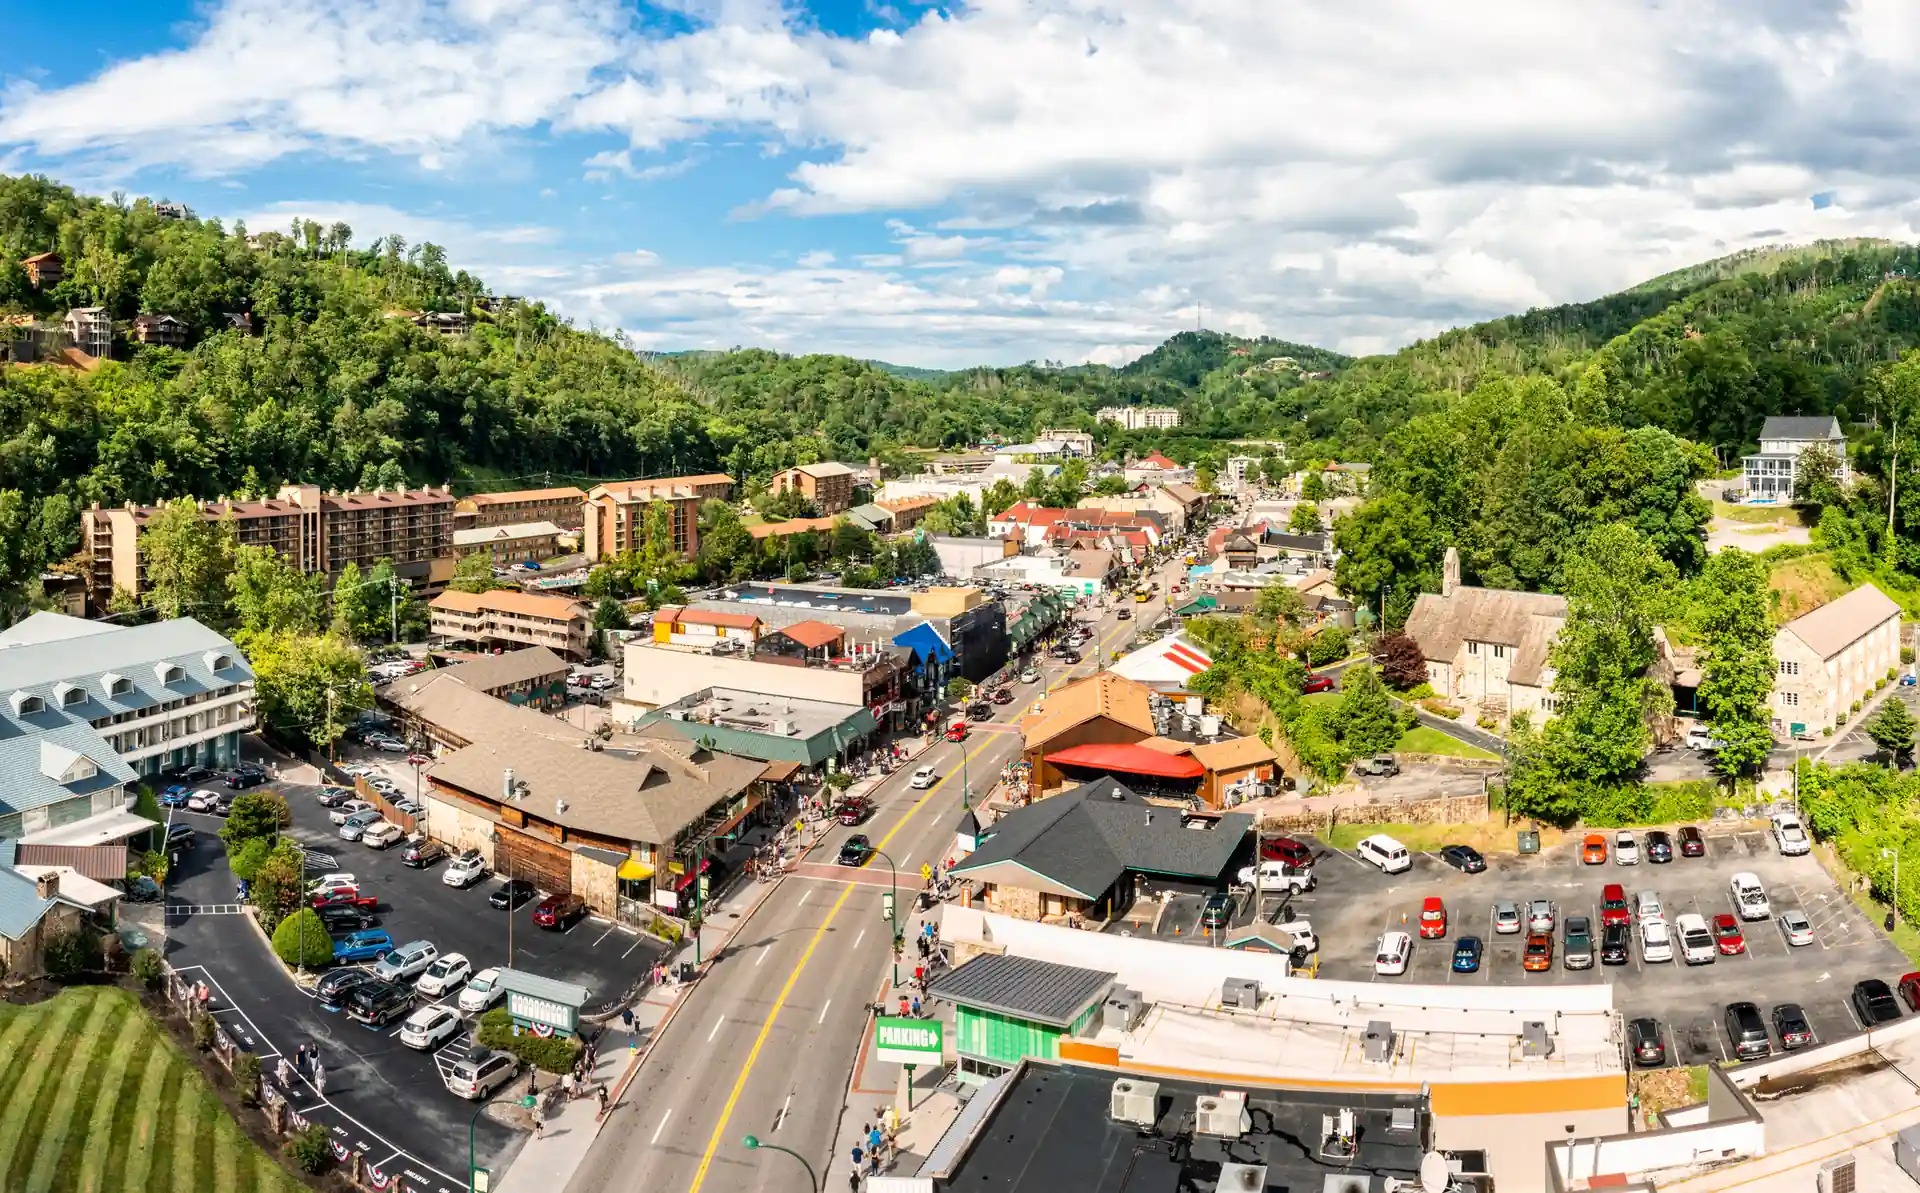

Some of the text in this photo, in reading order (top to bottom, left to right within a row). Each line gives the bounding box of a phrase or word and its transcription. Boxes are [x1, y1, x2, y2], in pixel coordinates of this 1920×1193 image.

[879, 1026, 929, 1048] PARKING
[332, 1126, 371, 1151] FIRE LANE
[403, 1168, 431, 1185] PARKING
